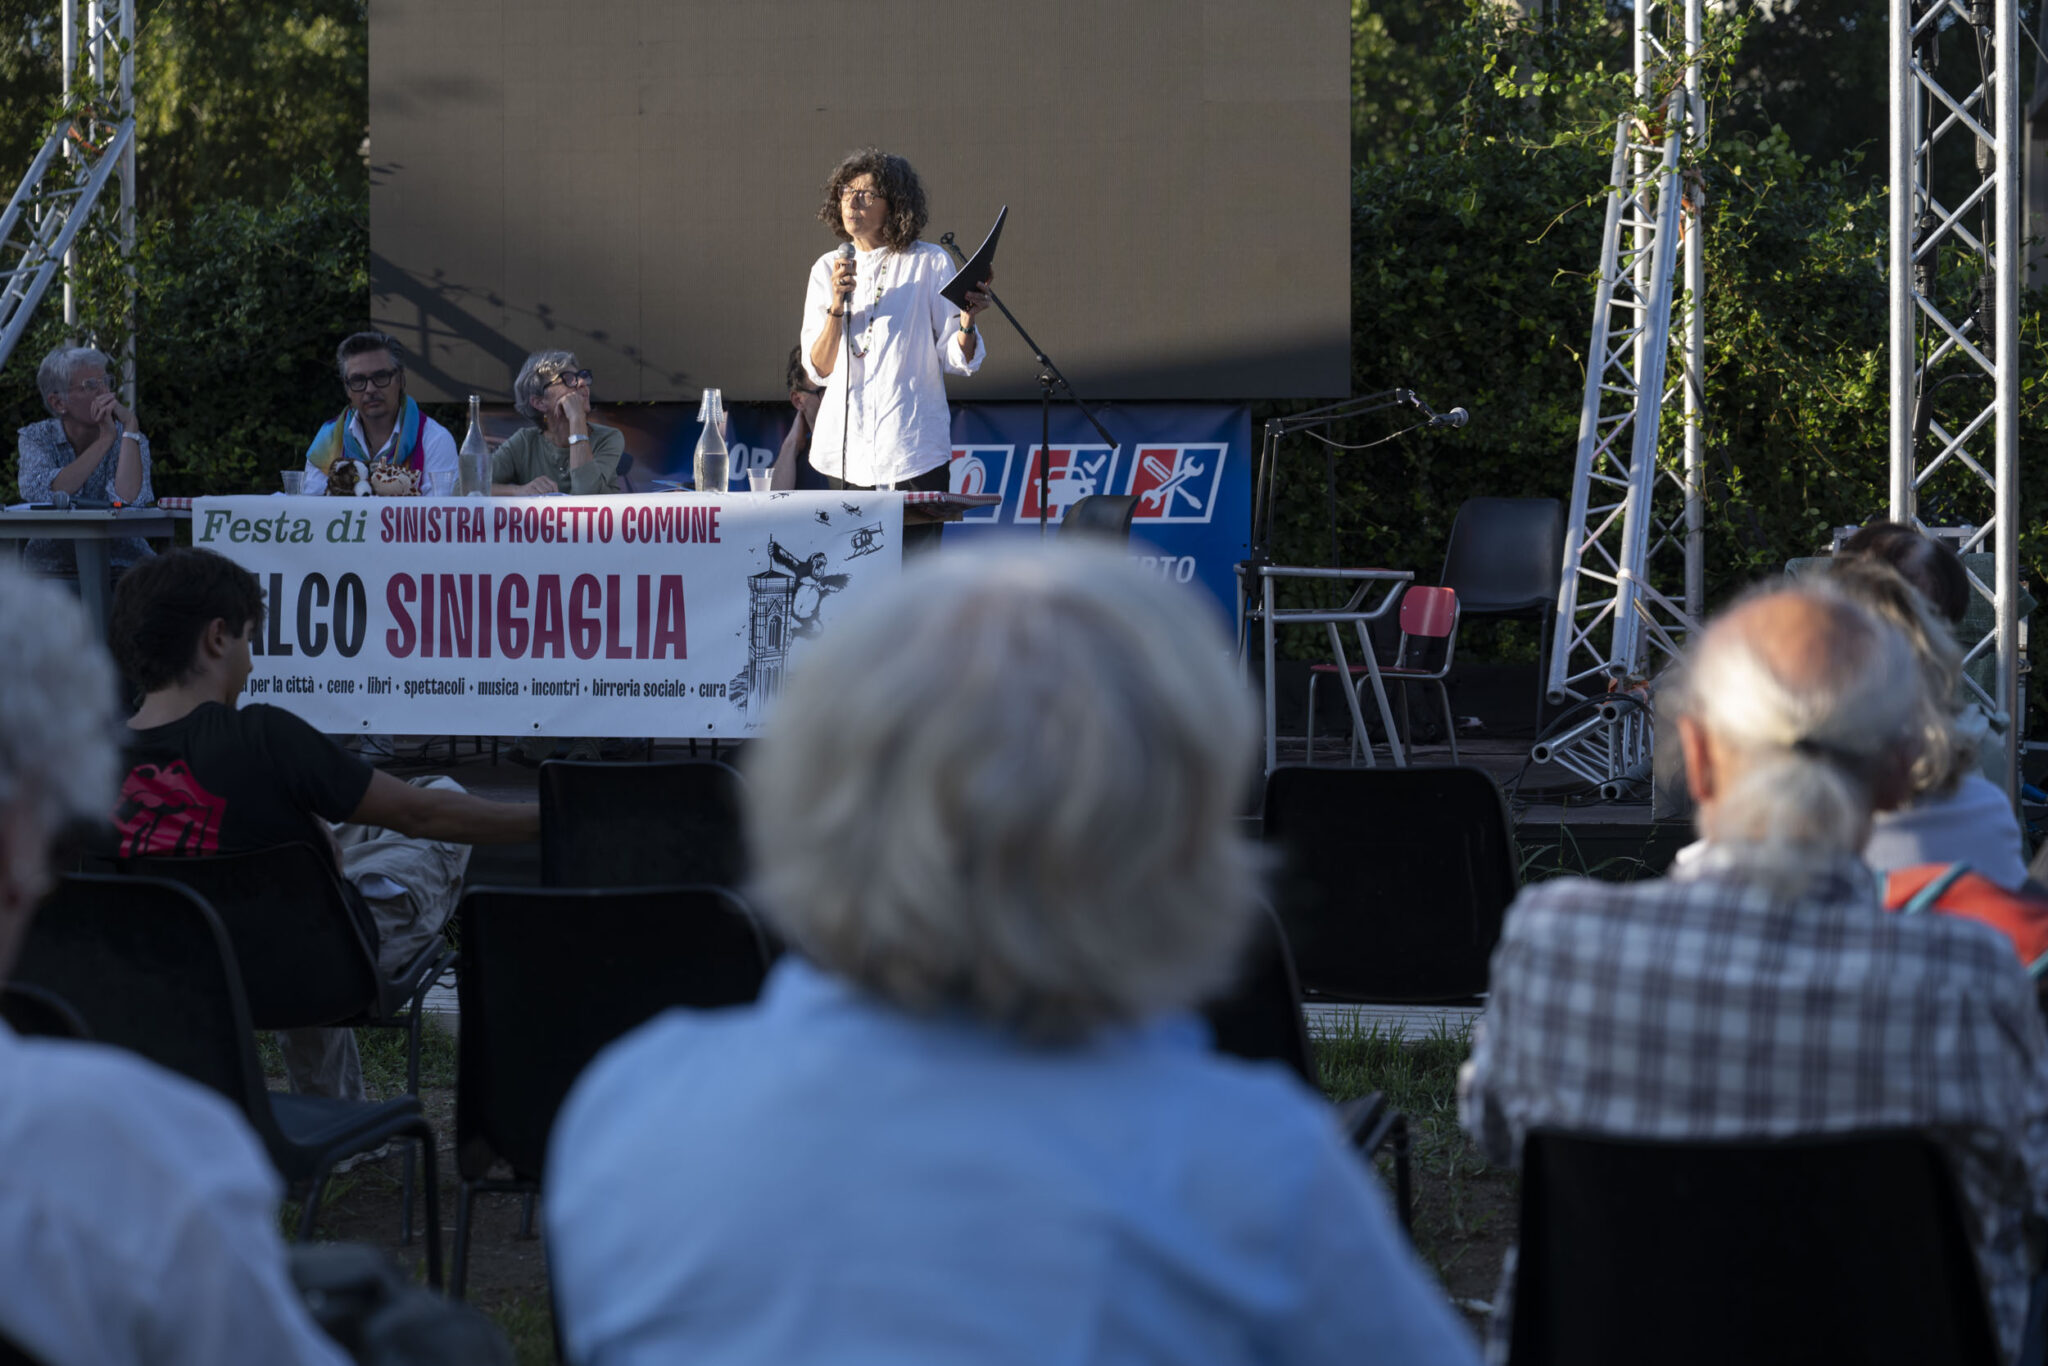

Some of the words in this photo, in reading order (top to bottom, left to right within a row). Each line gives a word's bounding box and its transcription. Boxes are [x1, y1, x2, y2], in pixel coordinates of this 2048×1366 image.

[198, 509, 314, 543] Festa
[326, 509, 369, 543] di
[380, 506, 487, 544] SINISTRA
[493, 506, 614, 544] PROGETTO
[621, 506, 722, 544] COMUNE
[385, 572, 688, 661] SINIGAGLIA
[250, 678, 270, 697] per
[273, 675, 283, 693] la
[286, 675, 315, 694] città
[327, 679, 355, 694] cene
[367, 676, 392, 695] libri
[403, 677, 465, 698] spettacoli
[477, 677, 519, 696] musica
[531, 678, 580, 696] incontri
[592, 678, 641, 697] birreria
[643, 679, 686, 698] sociale
[699, 682, 727, 698] cura
